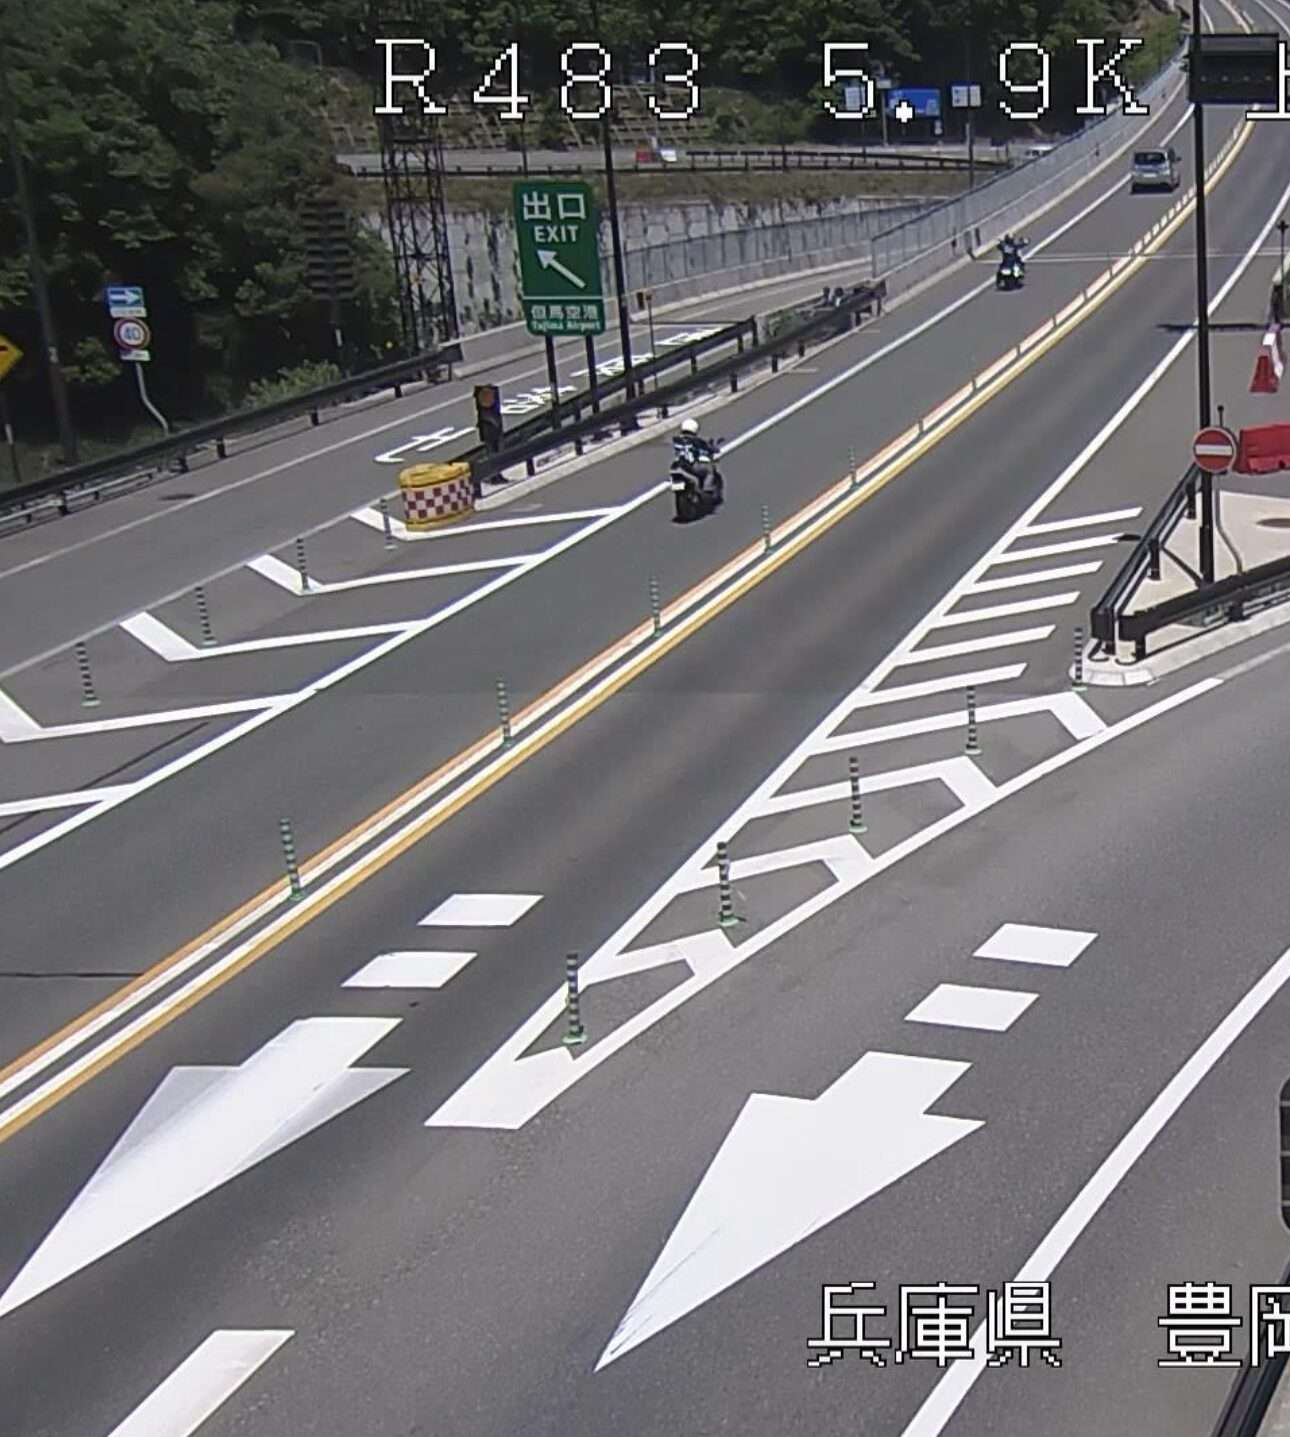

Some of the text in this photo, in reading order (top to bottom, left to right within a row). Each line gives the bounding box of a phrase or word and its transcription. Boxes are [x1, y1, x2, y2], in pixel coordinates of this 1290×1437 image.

[523, 191, 586, 220] 出口
[534, 225, 578, 243] EXIT
[531, 304, 599, 320] 但馬空港
[567, 318, 602, 333] Airport
